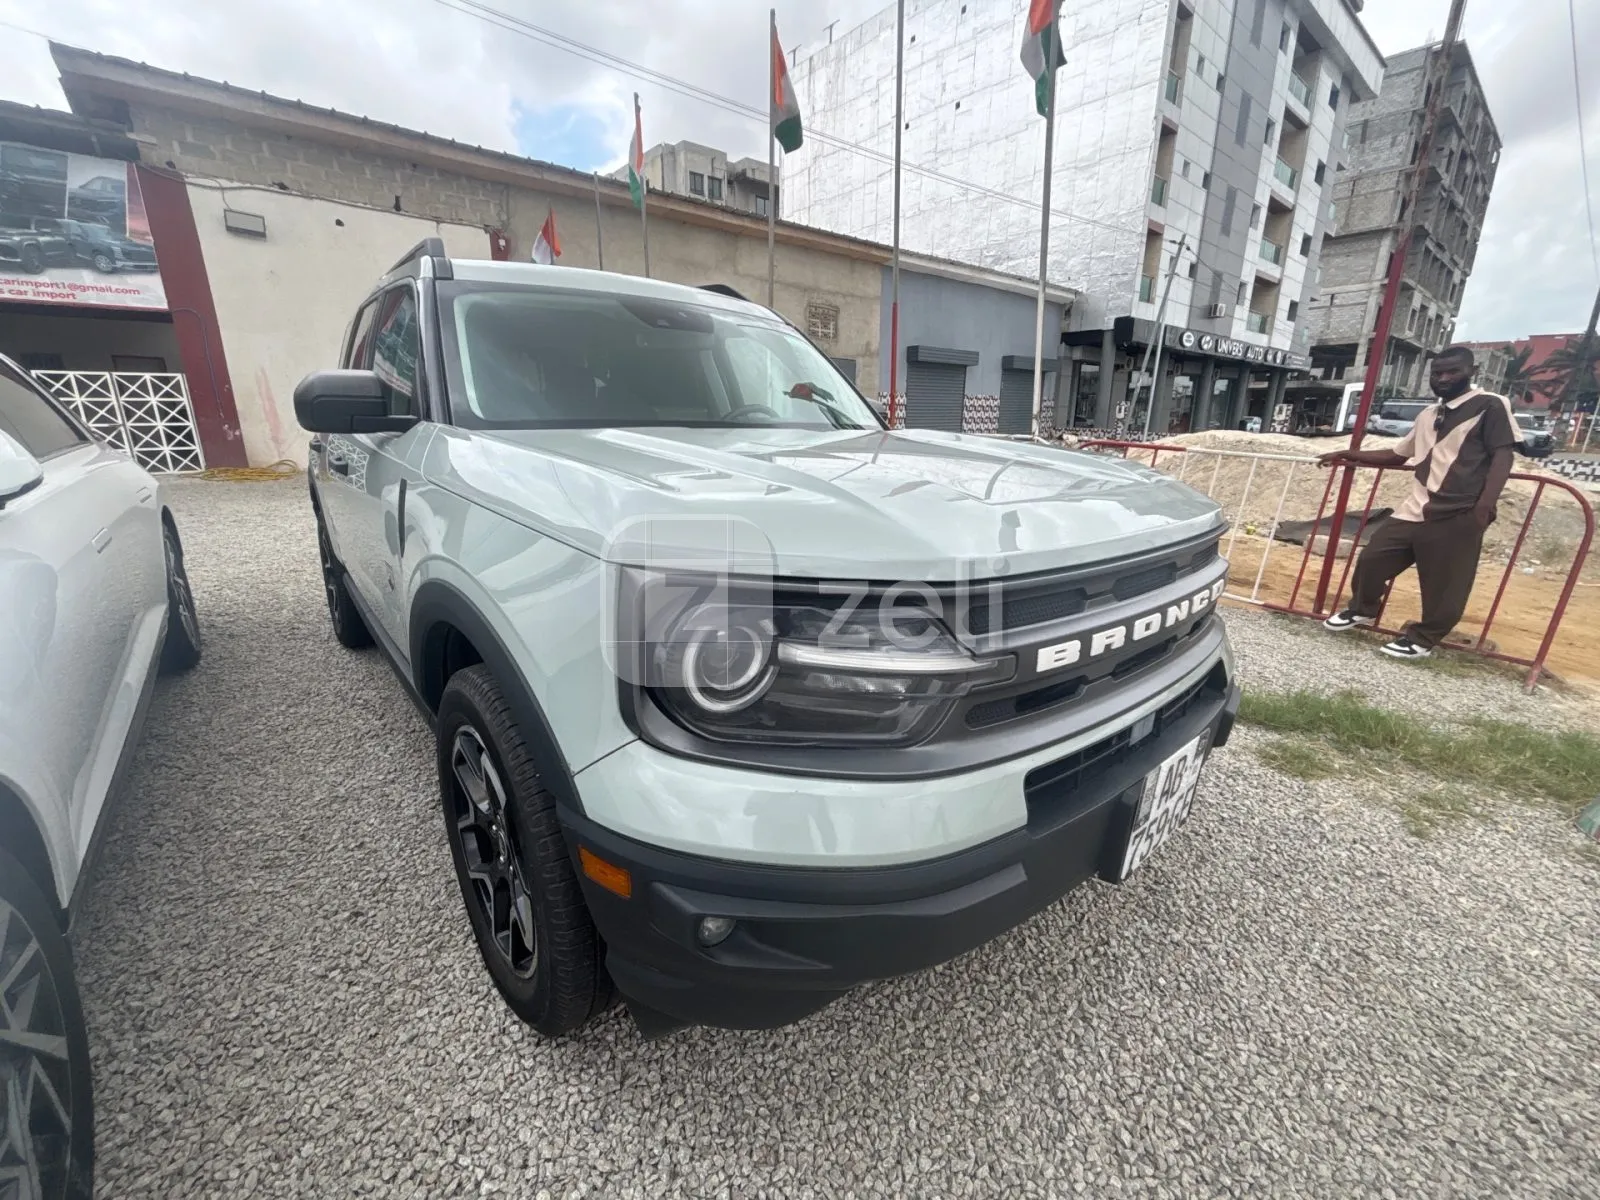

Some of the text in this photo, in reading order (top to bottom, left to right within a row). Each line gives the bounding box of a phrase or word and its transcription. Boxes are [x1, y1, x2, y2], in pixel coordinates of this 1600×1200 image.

[8, 288, 28, 296] car
[32, 289, 77, 300] import
[1217, 338, 1263, 360] UNIVERS AUTO
[1036, 578, 1225, 673] BRONCO
